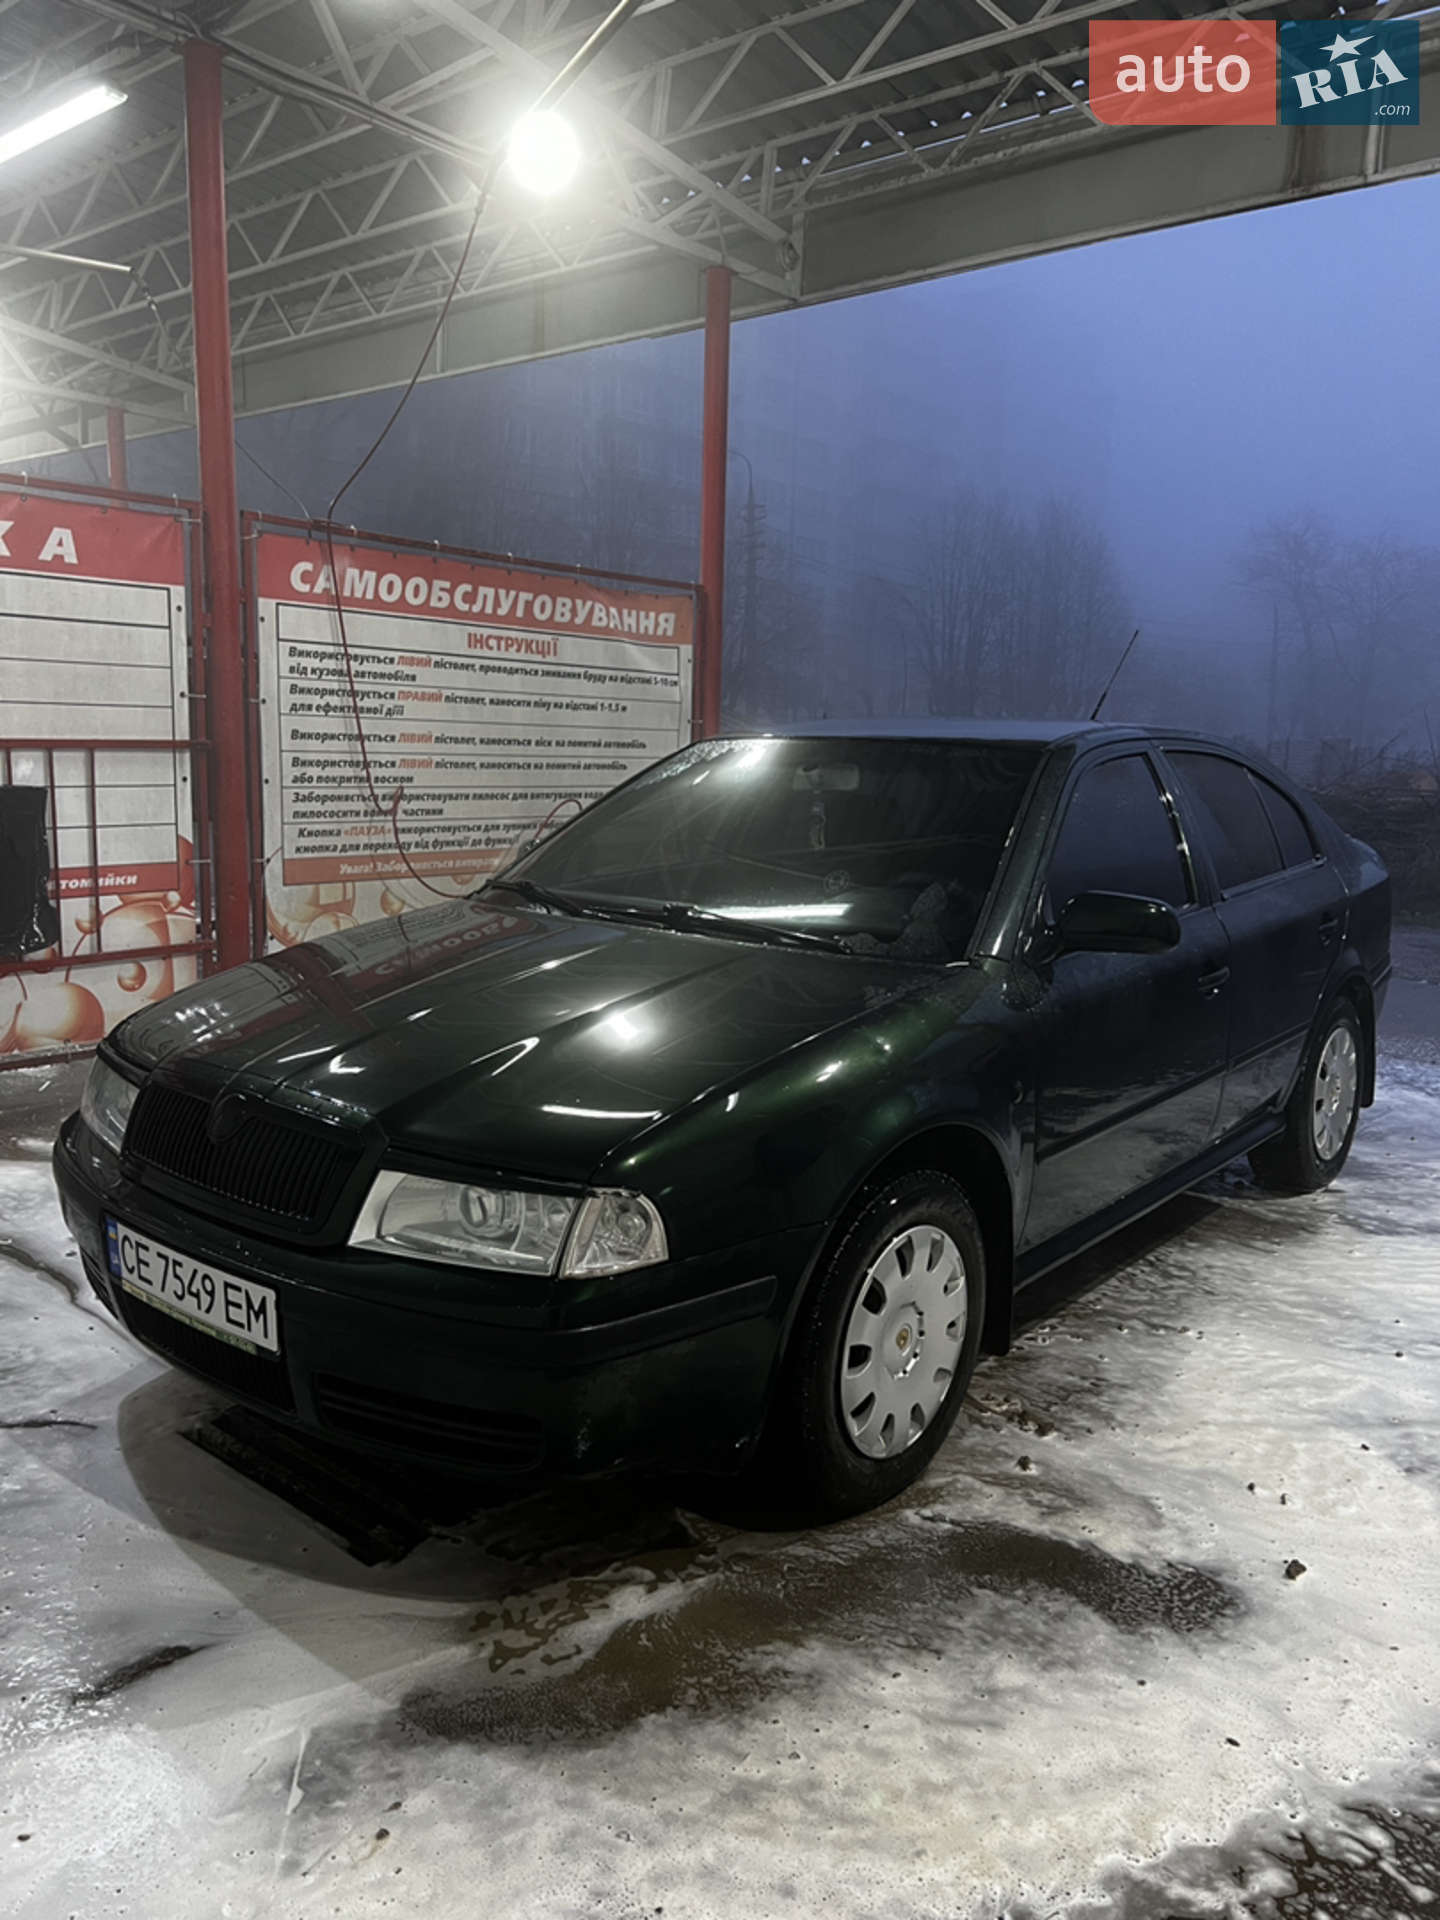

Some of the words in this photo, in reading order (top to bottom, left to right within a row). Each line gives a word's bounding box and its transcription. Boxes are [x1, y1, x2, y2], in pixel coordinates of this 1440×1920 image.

[289, 561, 677, 638] САМООБСЛУГОВУВАННЯ
[467, 632, 559, 659] ІНСТРУКЦІЇ
[288, 646, 395, 665] Використовується
[397, 655, 432, 669] ЛІВИЙ
[433, 658, 477, 673] пістолет,
[479, 664, 539, 676] проводиться
[583, 670, 607, 684] бруду
[608, 675, 618, 683] на
[620, 674, 652, 686] відстані
[289, 662, 308, 677] від
[353, 669, 417, 682] автомобіля
[289, 683, 396, 702] Використовується
[398, 690, 443, 703] ПРАВИЙ
[444, 693, 487, 706] пістолет,
[488, 698, 532, 708] наносити
[533, 698, 551, 711] піну
[553, 701, 563, 709] на
[565, 700, 598, 712] відстані
[289, 702, 313, 714] для
[290, 729, 397, 743] Використовється
[398, 731, 433, 744] ЛІВИЙ
[434, 733, 477, 746] пістолет,
[479, 737, 532, 746] наноситься
[534, 737, 553, 747] віск
[555, 739, 566, 748] на
[603, 738, 647, 749] автомобіль
[398, 756, 433, 769] ЛІВИЙ
[434, 758, 477, 771] пістолет,
[479, 761, 532, 770] наноситься
[533, 762, 544, 770] на
[583, 760, 628, 770] автомобіль
[291, 773, 314, 784] або
[374, 774, 414, 784] воском
[381, 792, 470, 804] виористовувати
[472, 792, 511, 801] пилосос
[511, 792, 529, 802] для
[292, 809, 361, 819] пилососити
[402, 807, 444, 817] частини
[298, 827, 341, 838] Кнопка
[396, 824, 482, 837] икористовується
[483, 824, 501, 834] для
[295, 845, 338, 854] кнопка
[339, 844, 360, 854] для
[414, 838, 430, 850] від
[431, 836, 469, 850] функції
[469, 837, 483, 847] до
[340, 862, 374, 875] Увага!
[121, 1234, 153, 1286] CE
[156, 1252, 216, 1315] 7549
[223, 1280, 270, 1340] EM
